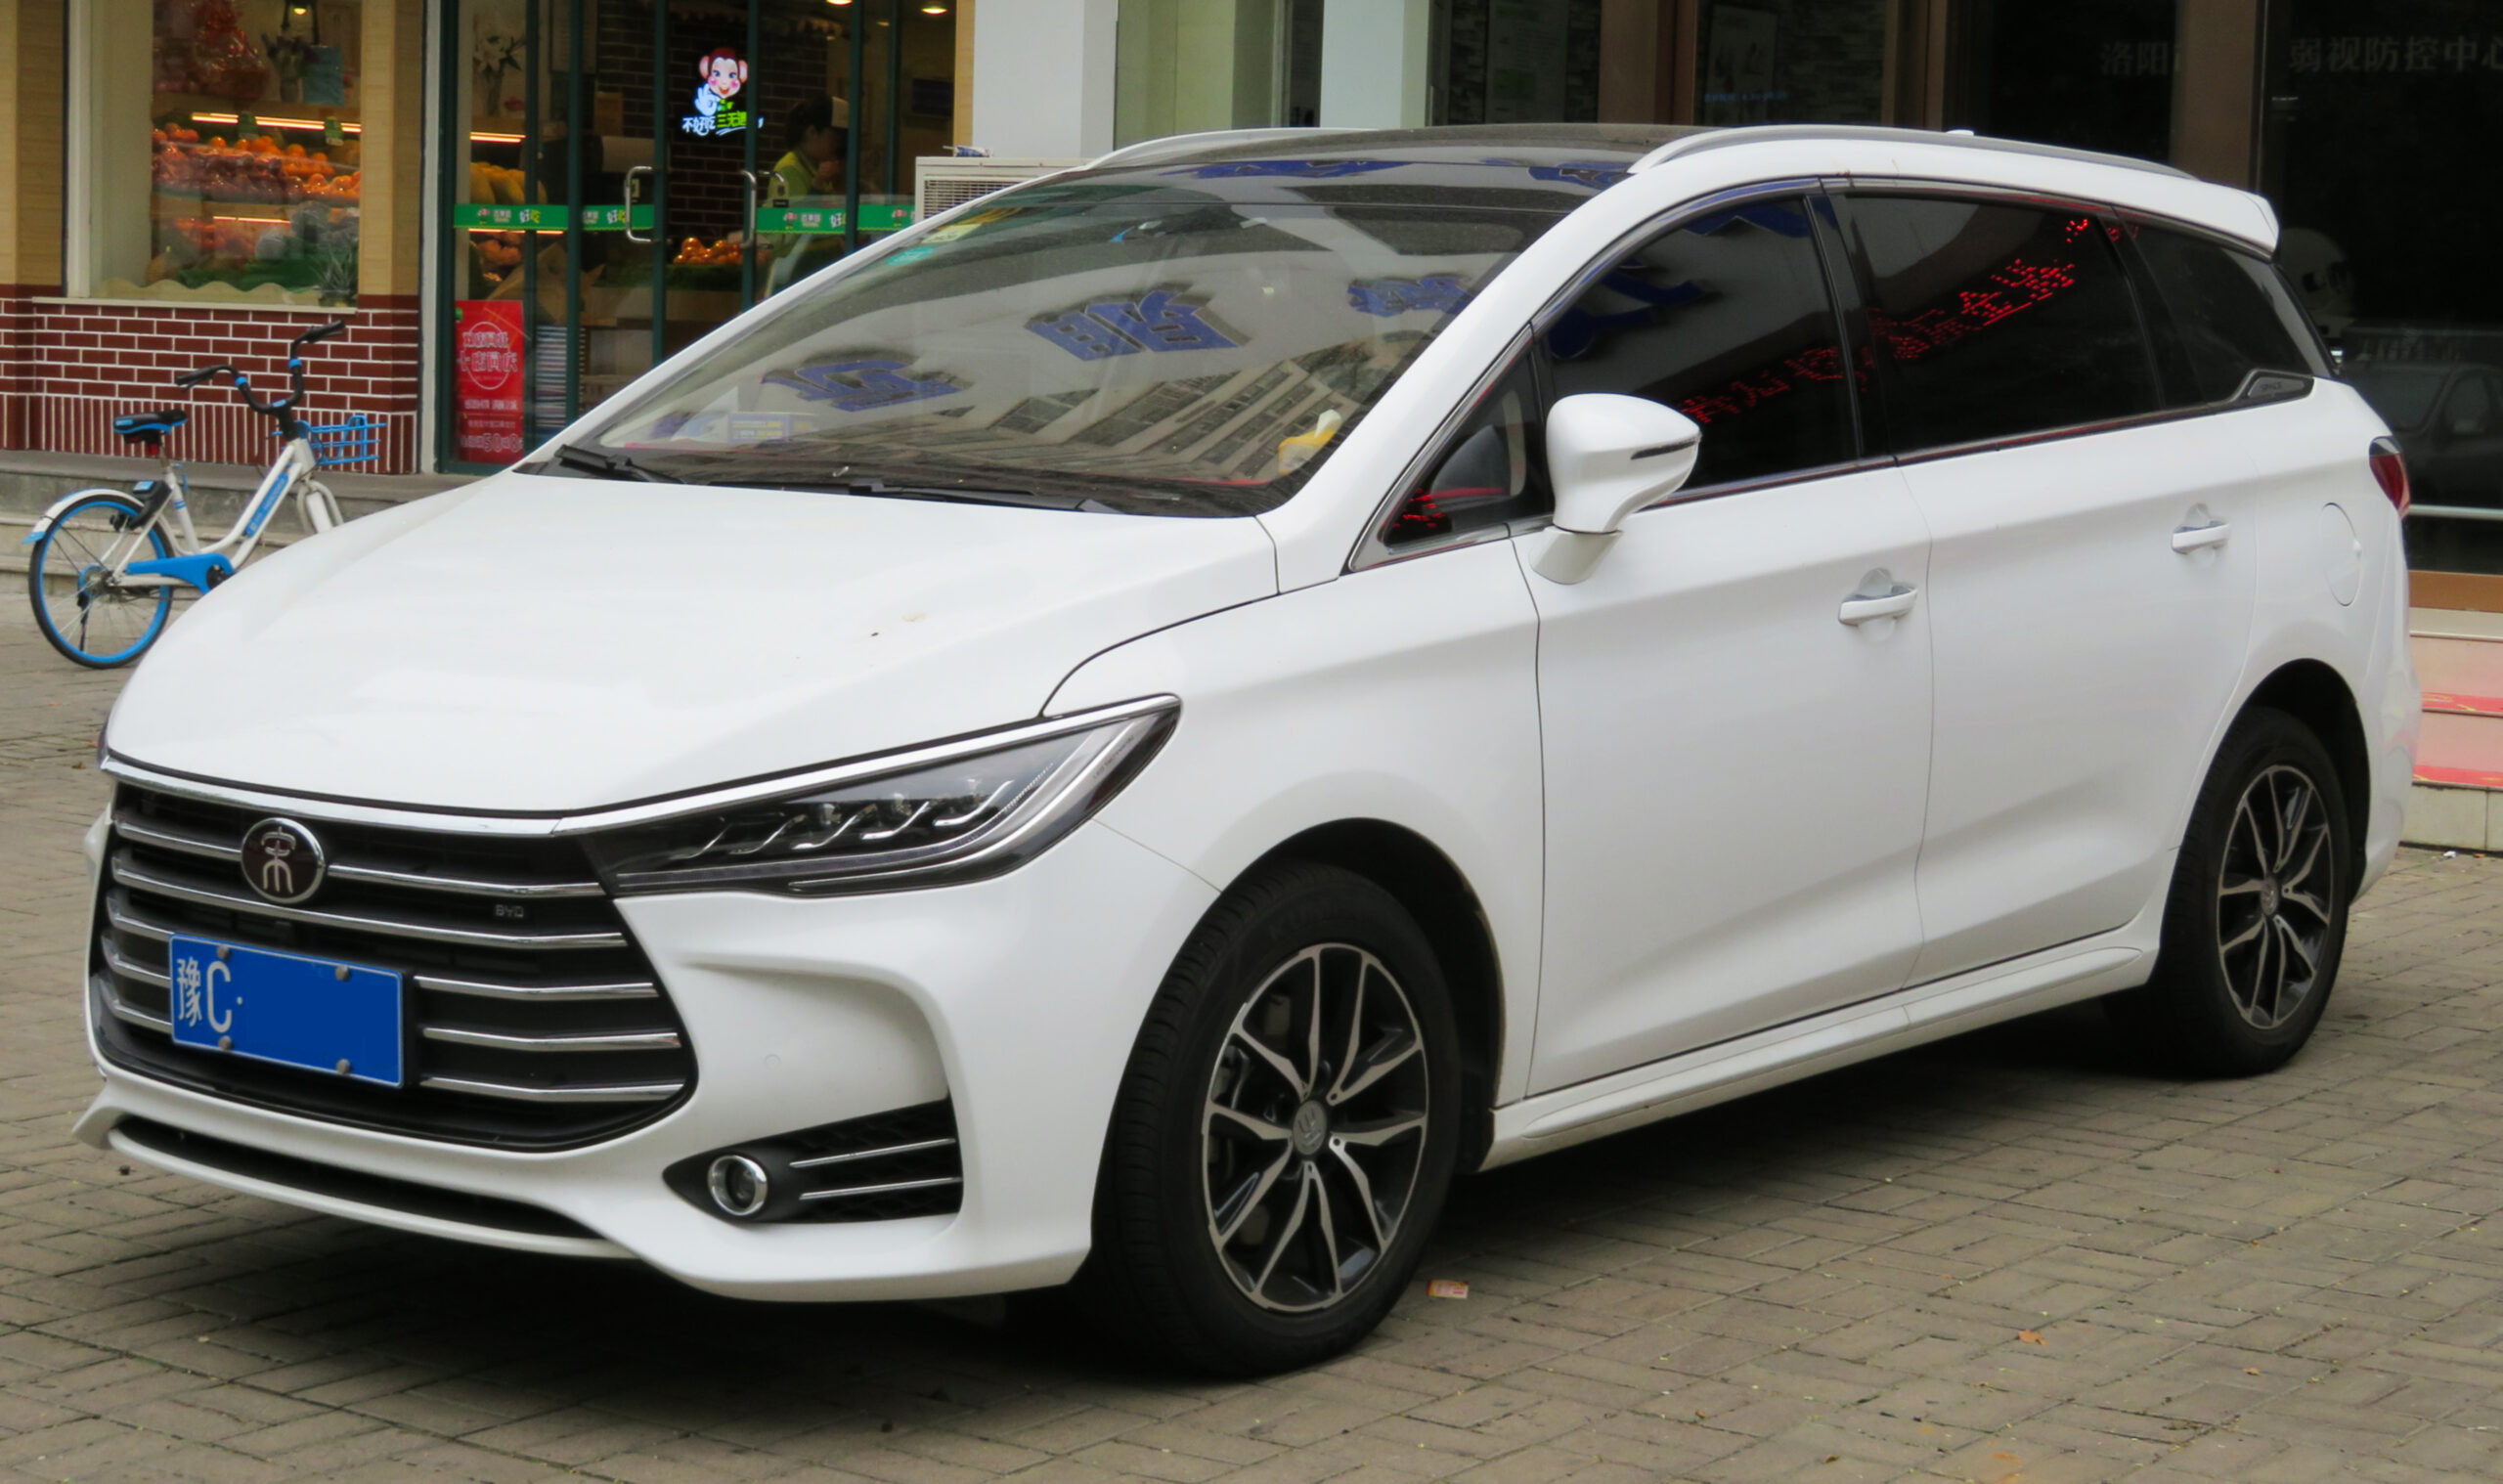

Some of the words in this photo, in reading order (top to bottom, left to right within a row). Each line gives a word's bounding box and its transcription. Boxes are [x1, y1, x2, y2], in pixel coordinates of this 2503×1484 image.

[2099, 39, 2179, 76] 洛阳
[829, 212, 847, 228] 好
[495, 904, 524, 918] BYD
